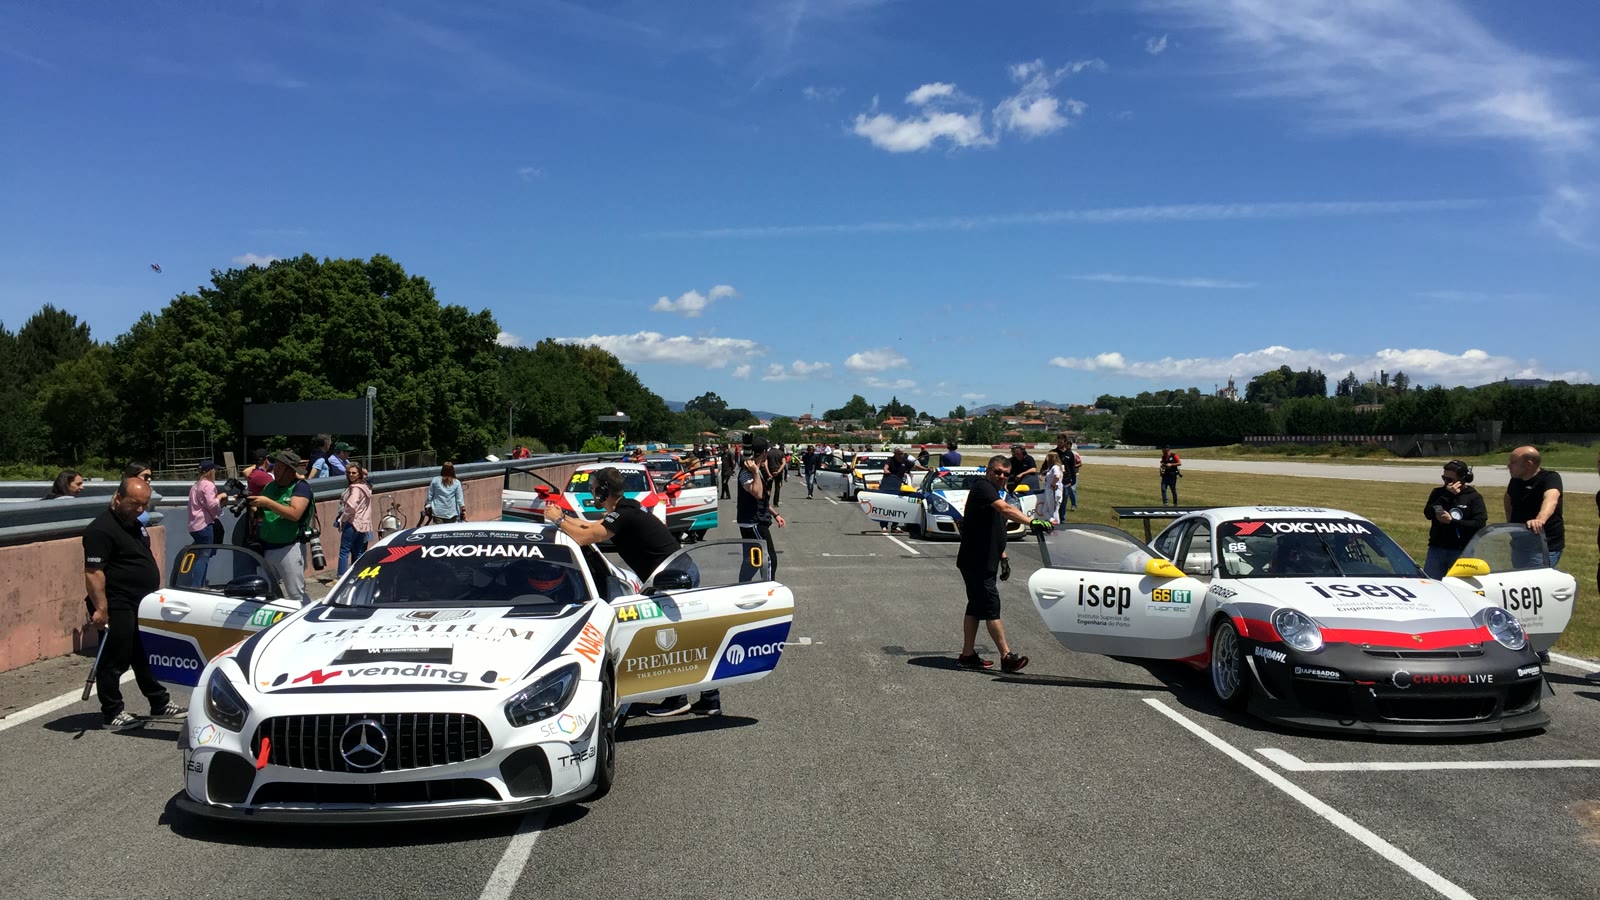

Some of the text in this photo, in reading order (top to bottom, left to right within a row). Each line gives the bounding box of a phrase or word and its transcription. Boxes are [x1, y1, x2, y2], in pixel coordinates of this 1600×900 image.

[1265, 522, 1372, 535] YOKOHAMA
[420, 544, 545, 559] YOKOHAMA
[1228, 542, 1247, 551] 66
[357, 565, 382, 579] 44
[1077, 577, 1131, 615] isep
[1153, 589, 1171, 602] 66
[1173, 590, 1190, 603] GT
[1305, 581, 1418, 603] isep
[1498, 581, 1543, 615] isep
[253, 609, 273, 626] GT
[618, 605, 638, 622] 44
[640, 602, 659, 619] GT
[303, 624, 534, 644] PREMIUM
[149, 654, 199, 670] maroco
[625, 646, 708, 673] PREMIUM
[1255, 645, 1287, 664] BARDAHL
[347, 664, 469, 683] vending
[653, 669, 672, 677] SOFA
[673, 664, 699, 673] TAILOR
